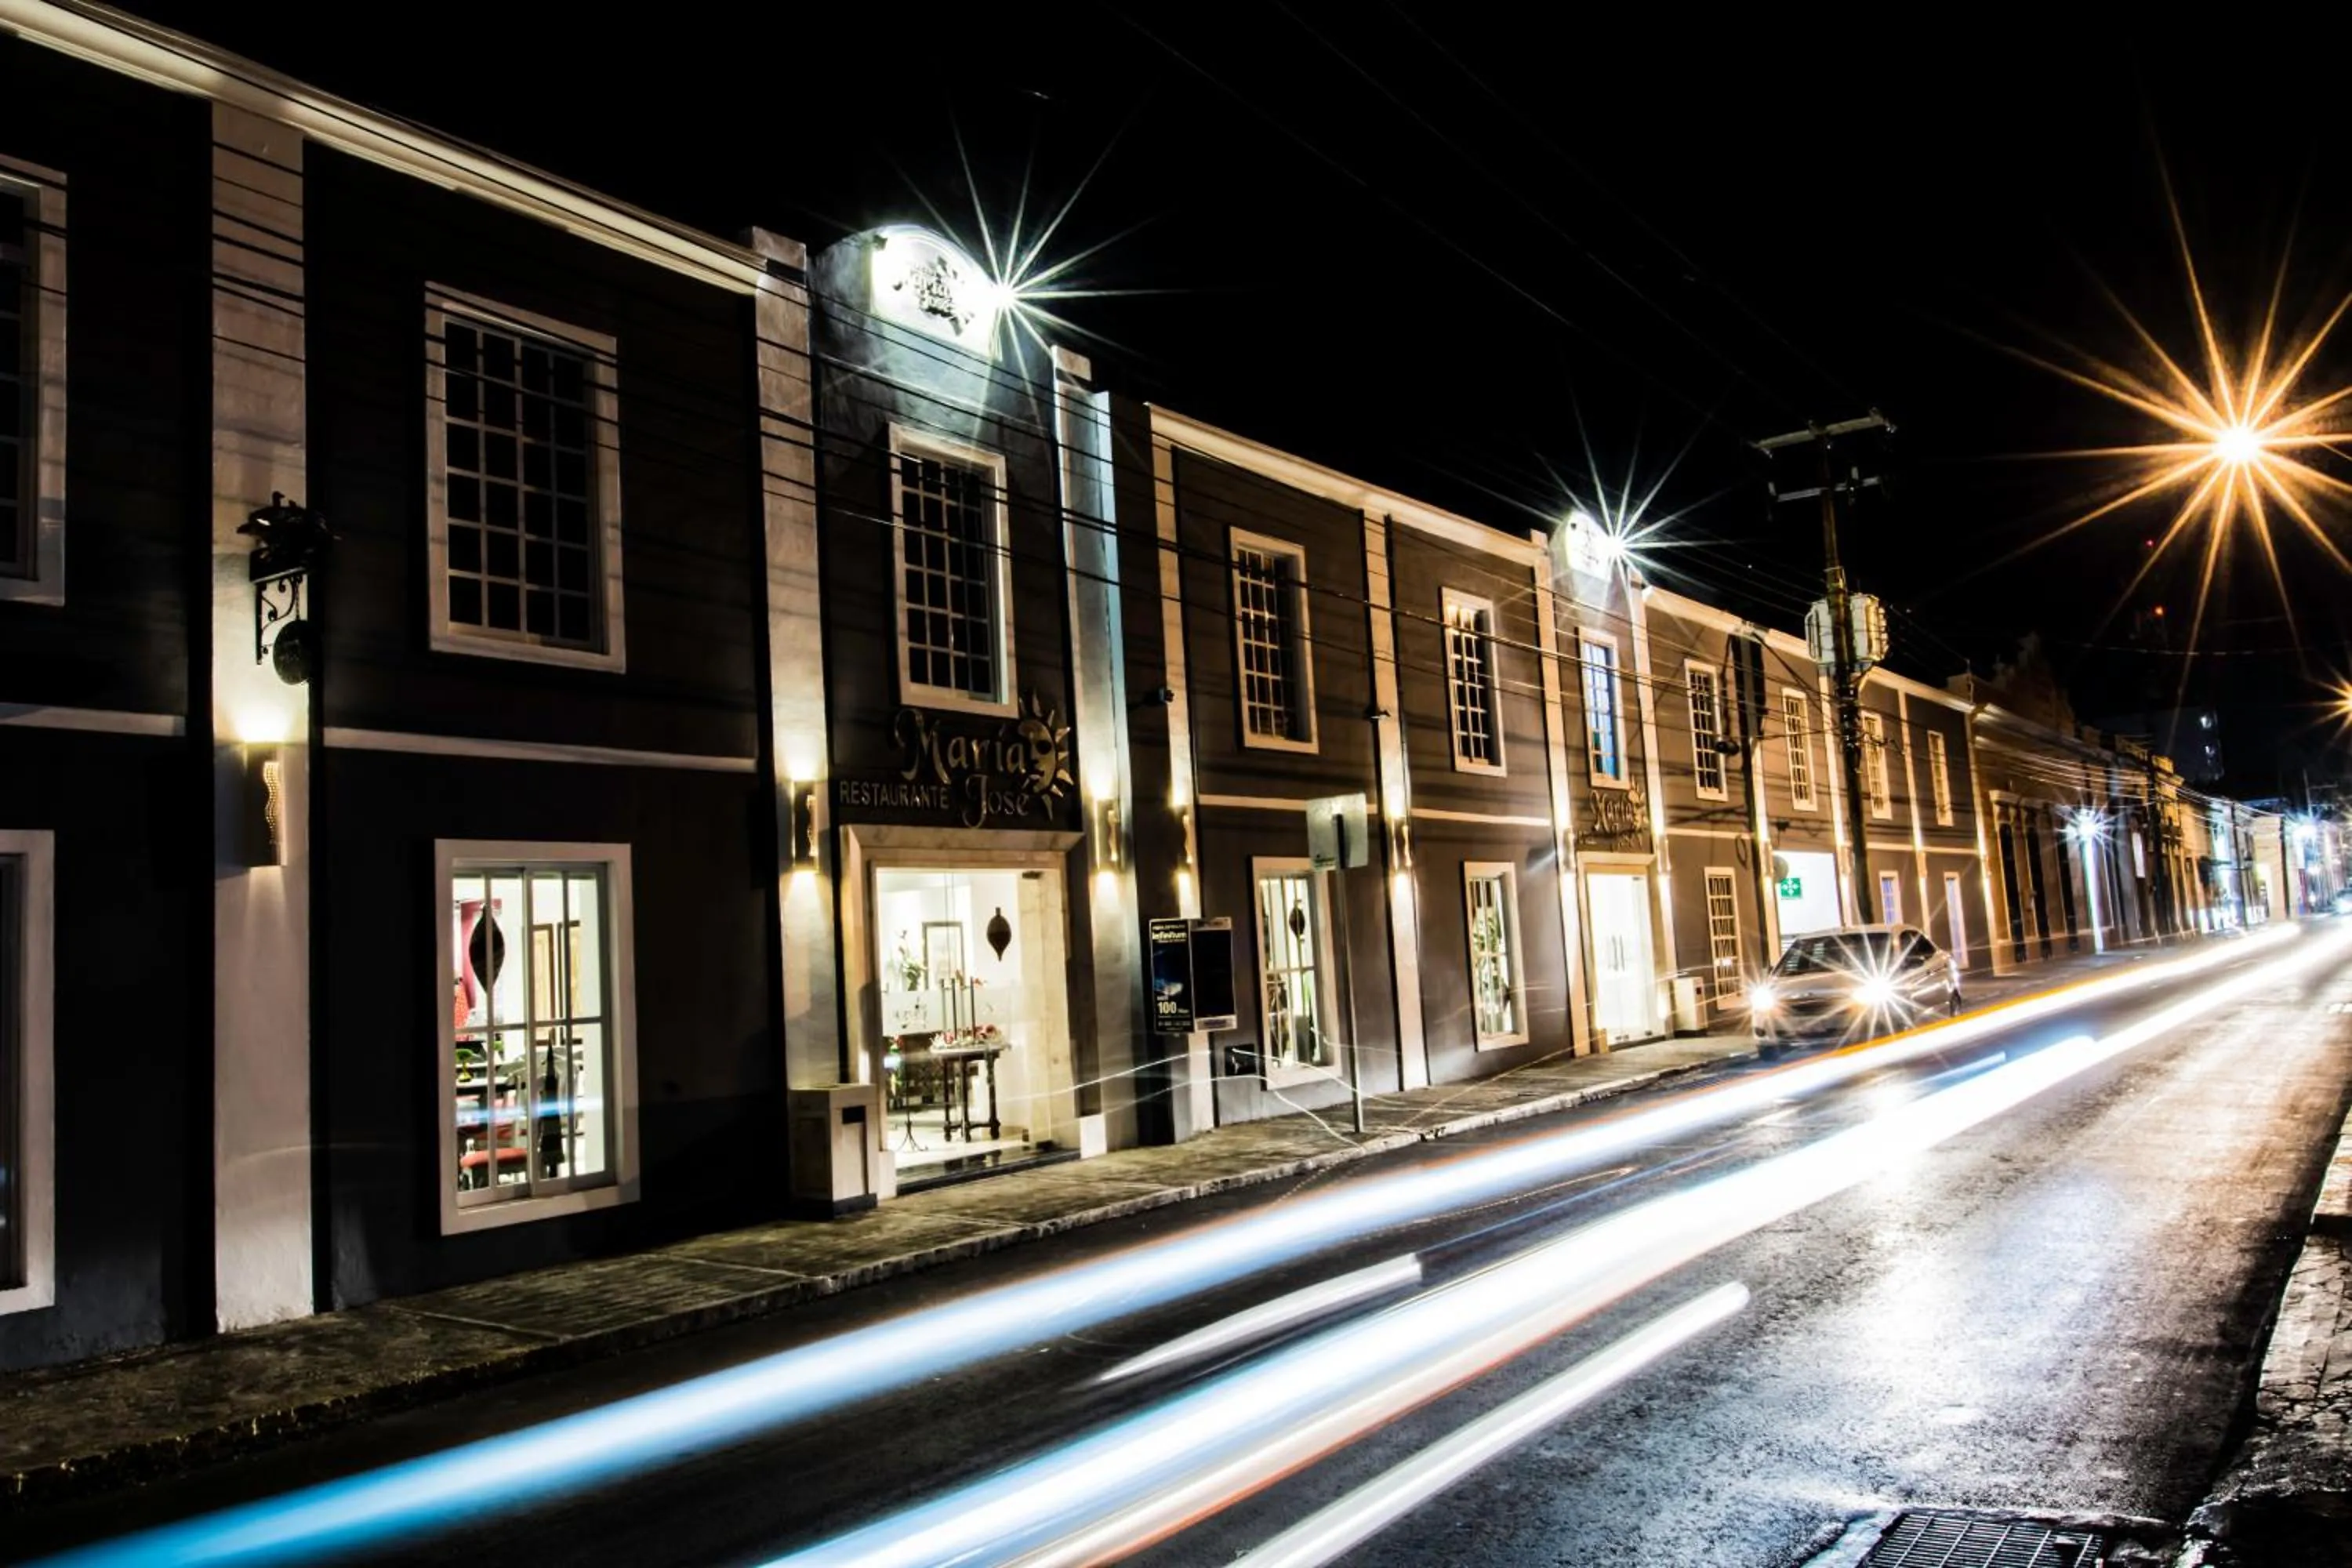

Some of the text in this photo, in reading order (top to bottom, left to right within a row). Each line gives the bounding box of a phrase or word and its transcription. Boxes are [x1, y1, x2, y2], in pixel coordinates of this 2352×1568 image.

[893, 707, 1028, 785] María
[839, 779, 951, 811] RESTAURANTE
[961, 773, 1030, 829] José
[1157, 1001, 1177, 1014] 100
